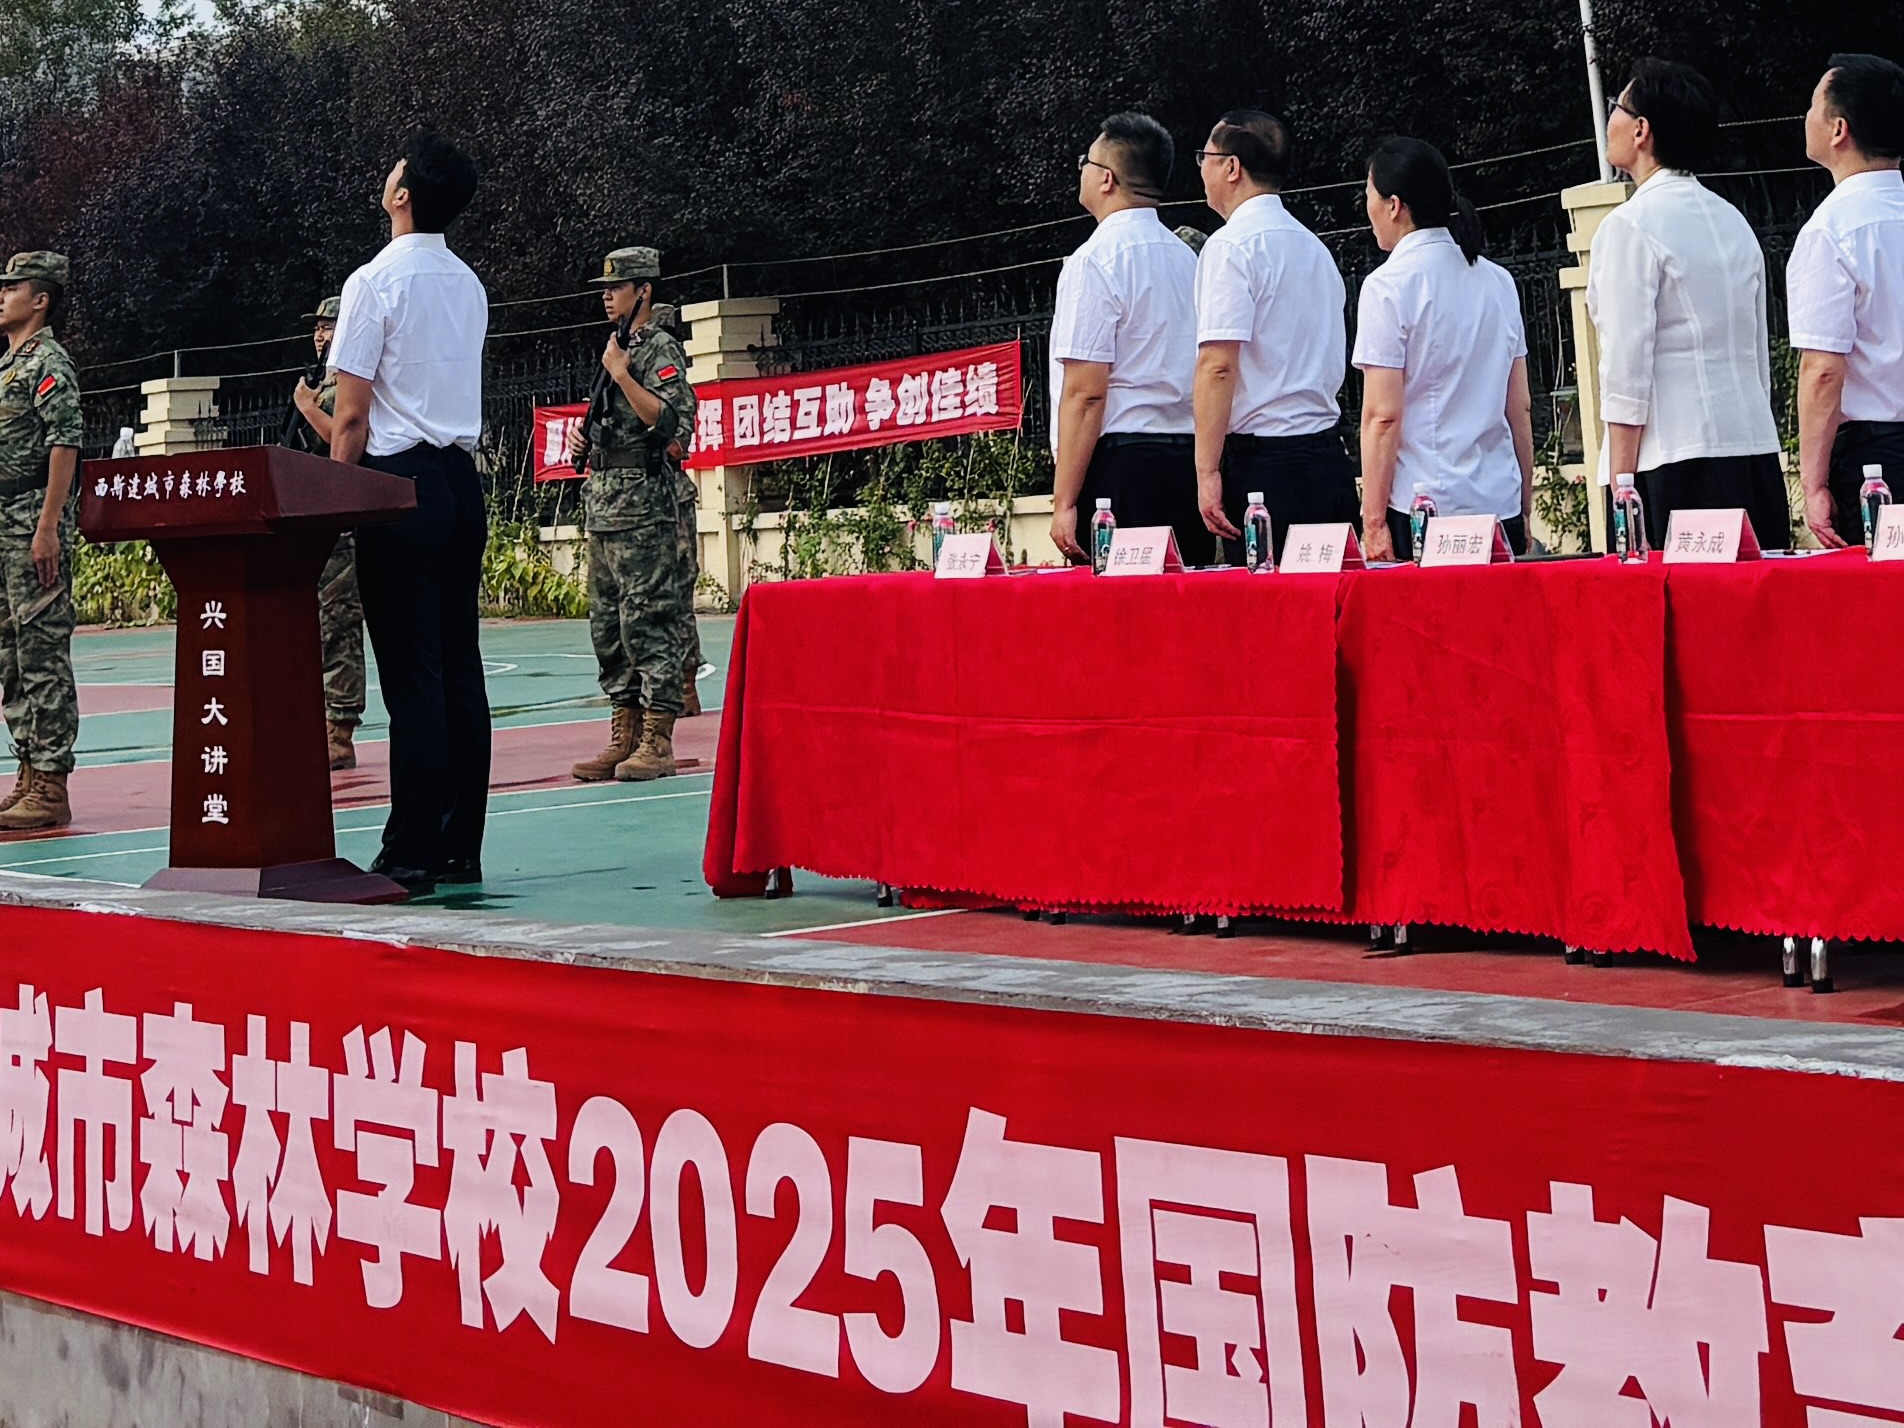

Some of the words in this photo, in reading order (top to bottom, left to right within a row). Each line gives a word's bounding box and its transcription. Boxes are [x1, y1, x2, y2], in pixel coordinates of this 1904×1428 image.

[732, 380, 858, 448] 团结互助
[865, 361, 999, 426] 争创佳绩
[1675, 531, 1725, 554] 黄永成
[200, 600, 229, 825] 兴国大讲堂
